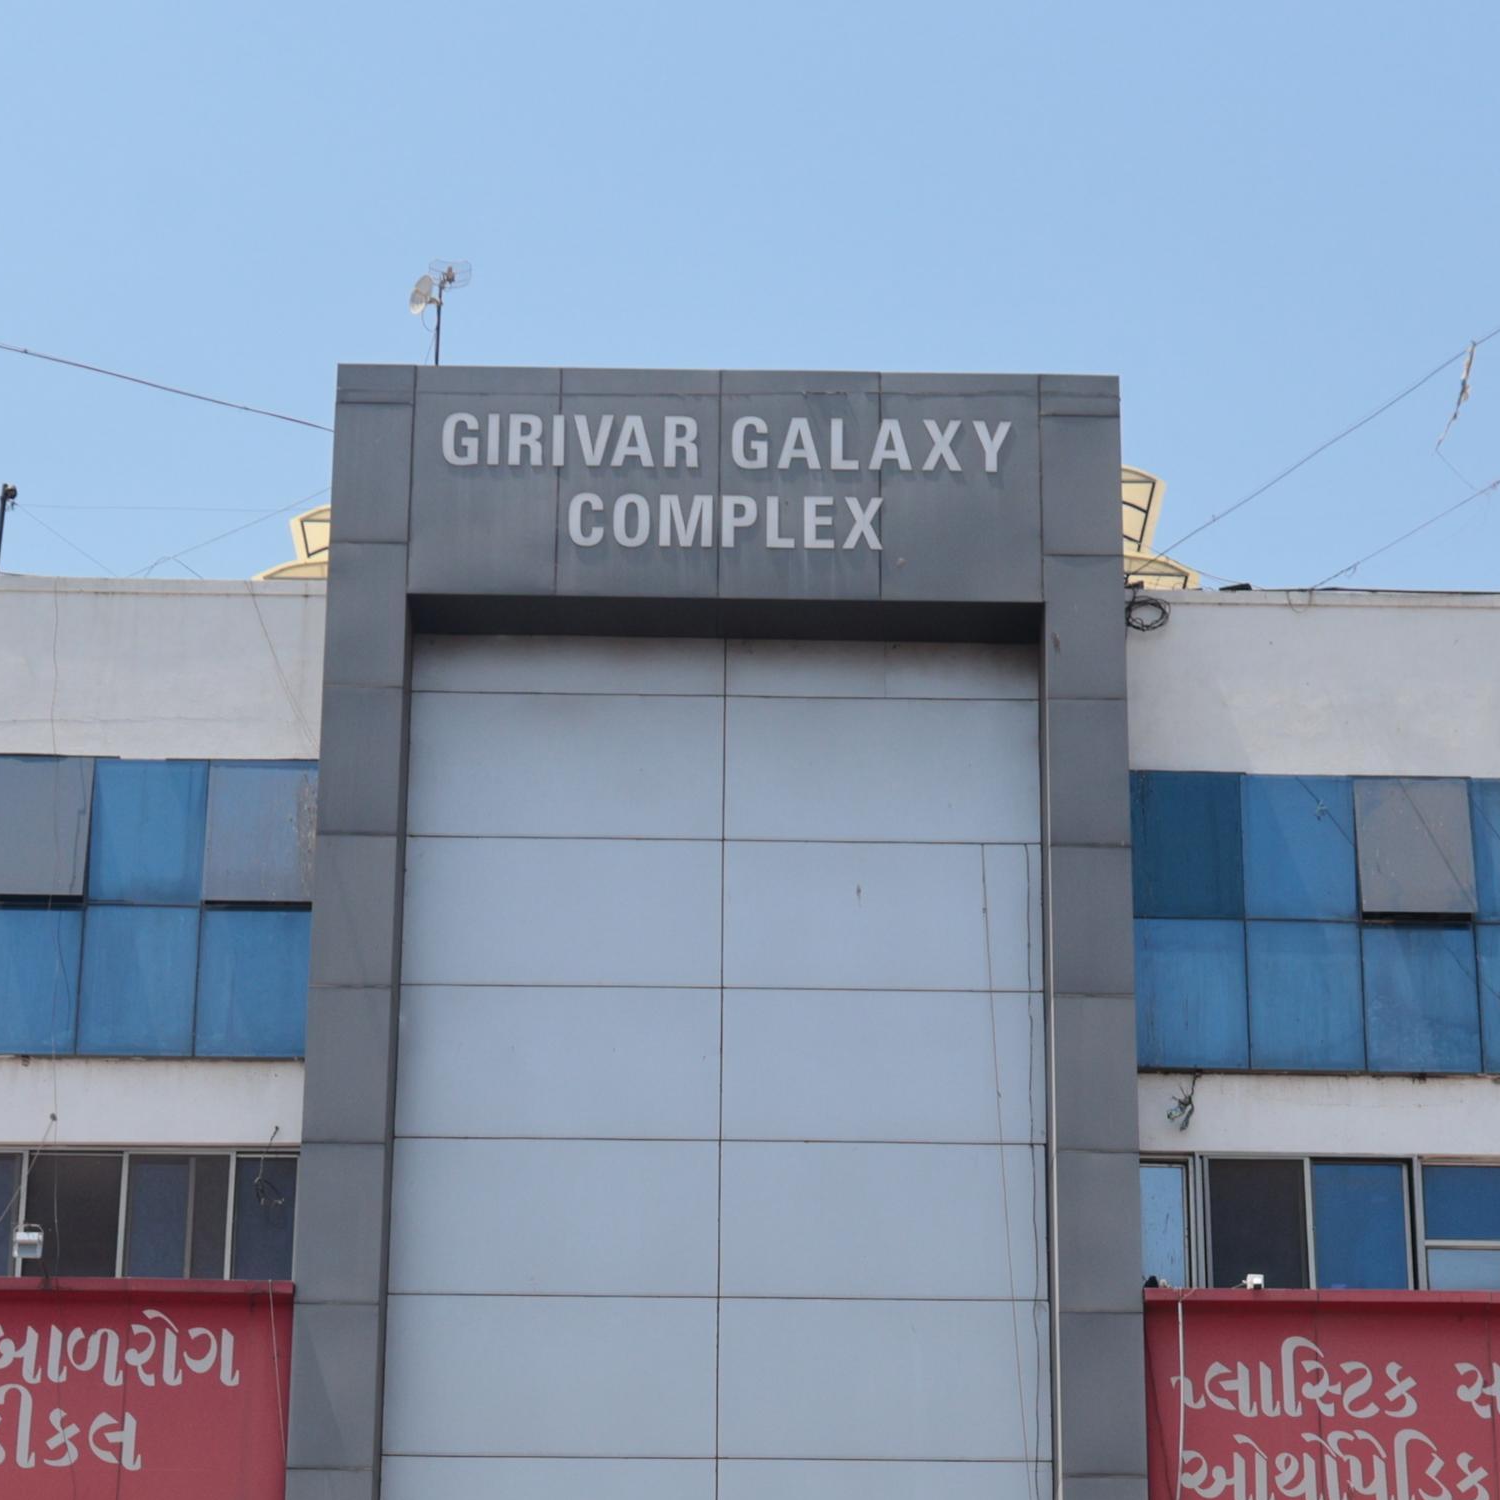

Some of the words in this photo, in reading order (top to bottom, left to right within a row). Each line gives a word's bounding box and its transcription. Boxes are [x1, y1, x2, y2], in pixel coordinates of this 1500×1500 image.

[442, 411, 700, 469] GIRIVAR
[730, 414, 1013, 474] GALAXY
[567, 491, 884, 551] COMPLEX
